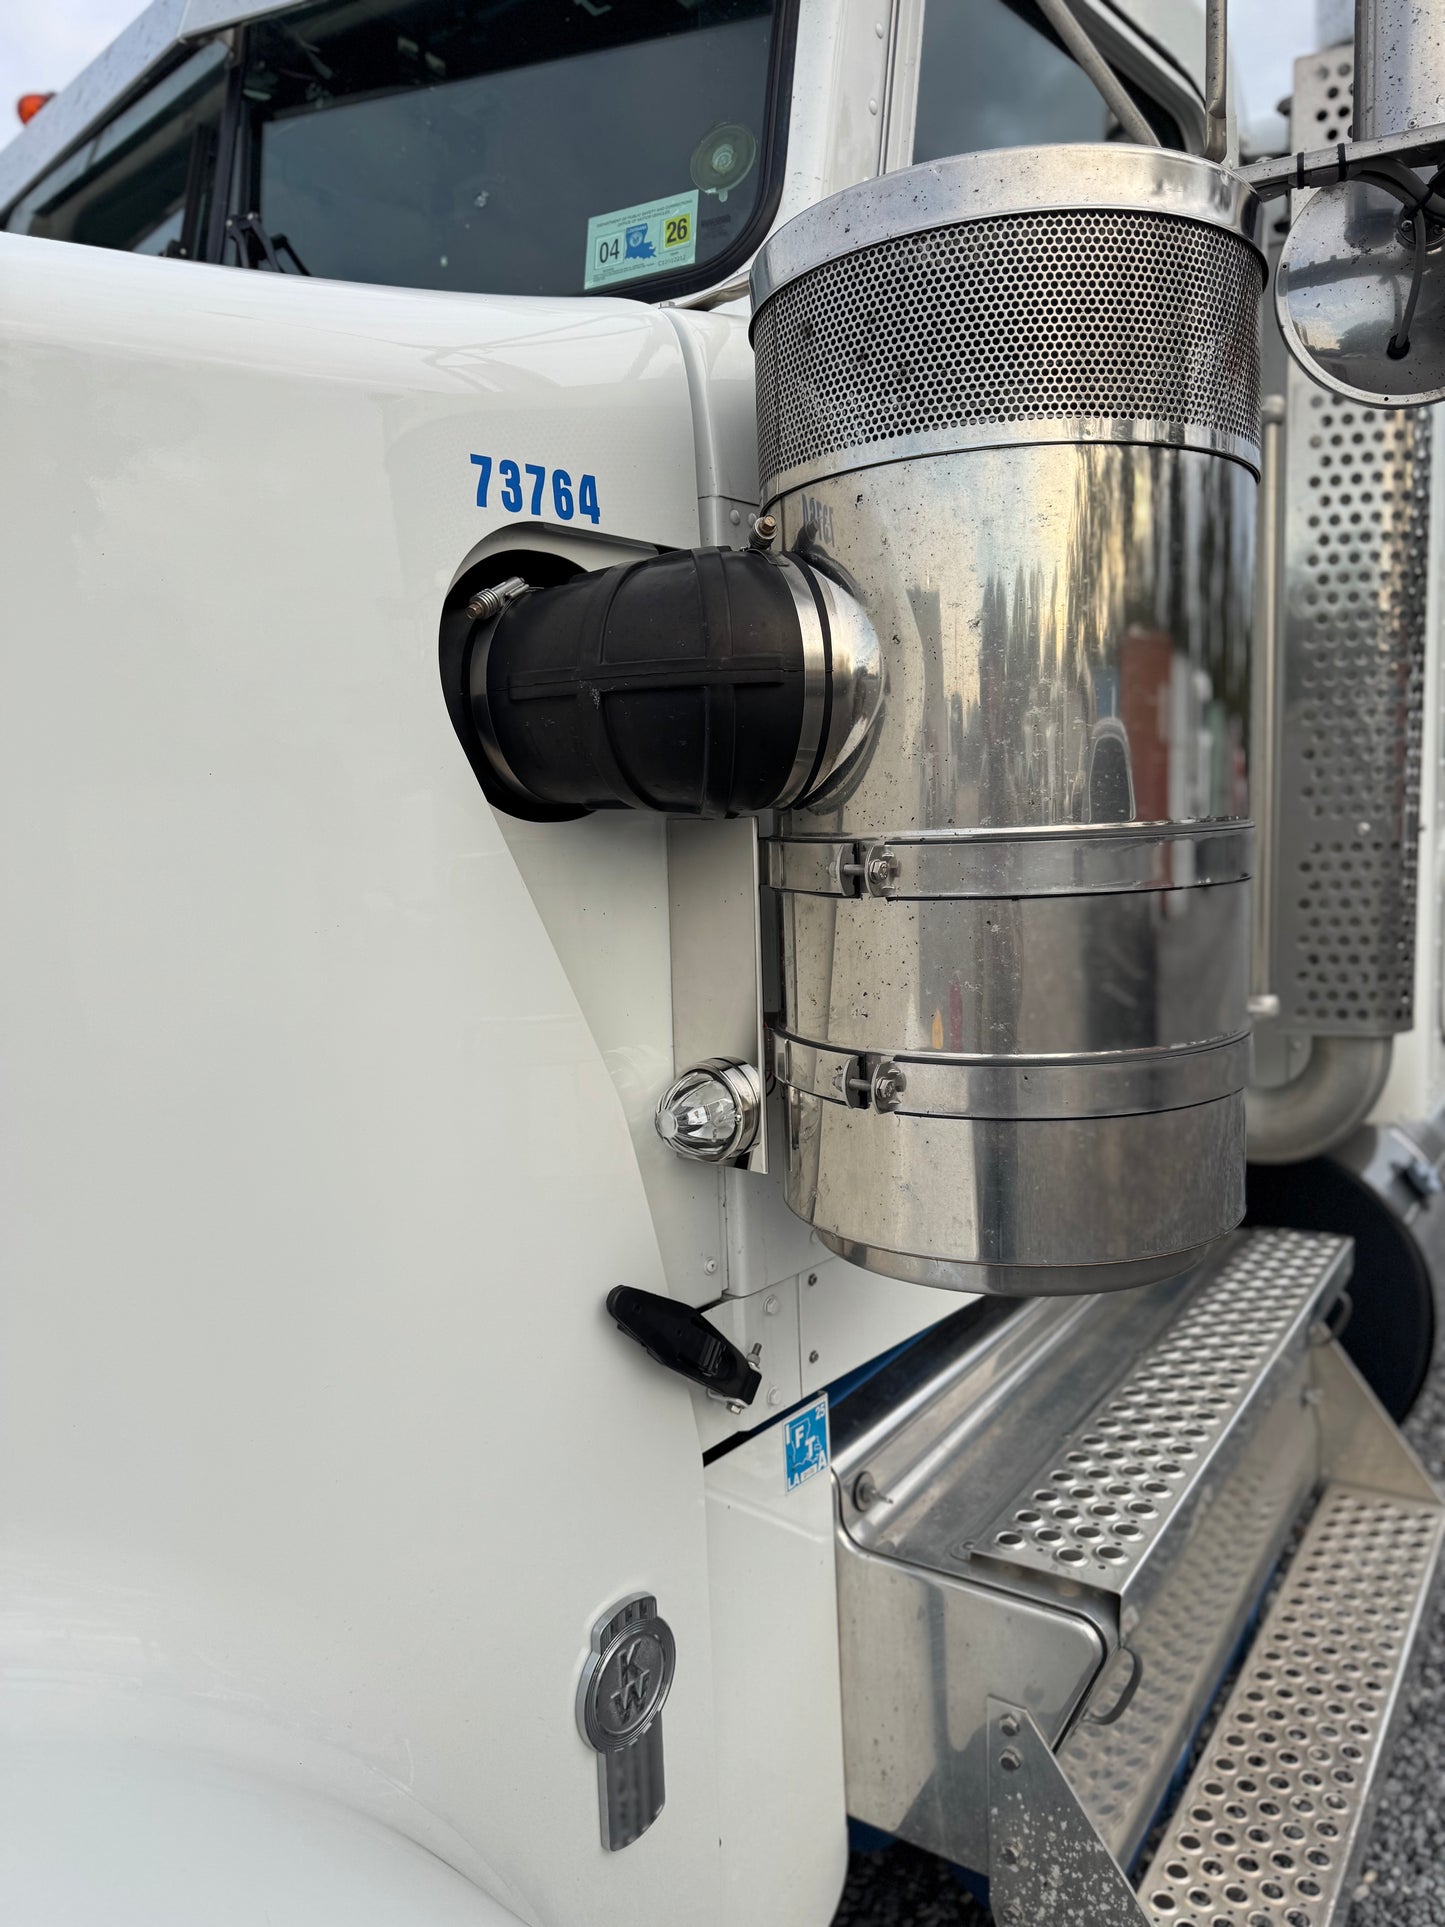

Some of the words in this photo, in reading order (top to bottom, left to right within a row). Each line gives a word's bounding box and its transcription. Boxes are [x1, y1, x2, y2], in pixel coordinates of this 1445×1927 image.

[666, 217, 688, 244] 26
[599, 238, 620, 263] 04
[470, 453, 600, 525] 73764
[815, 1403, 826, 1421] 25
